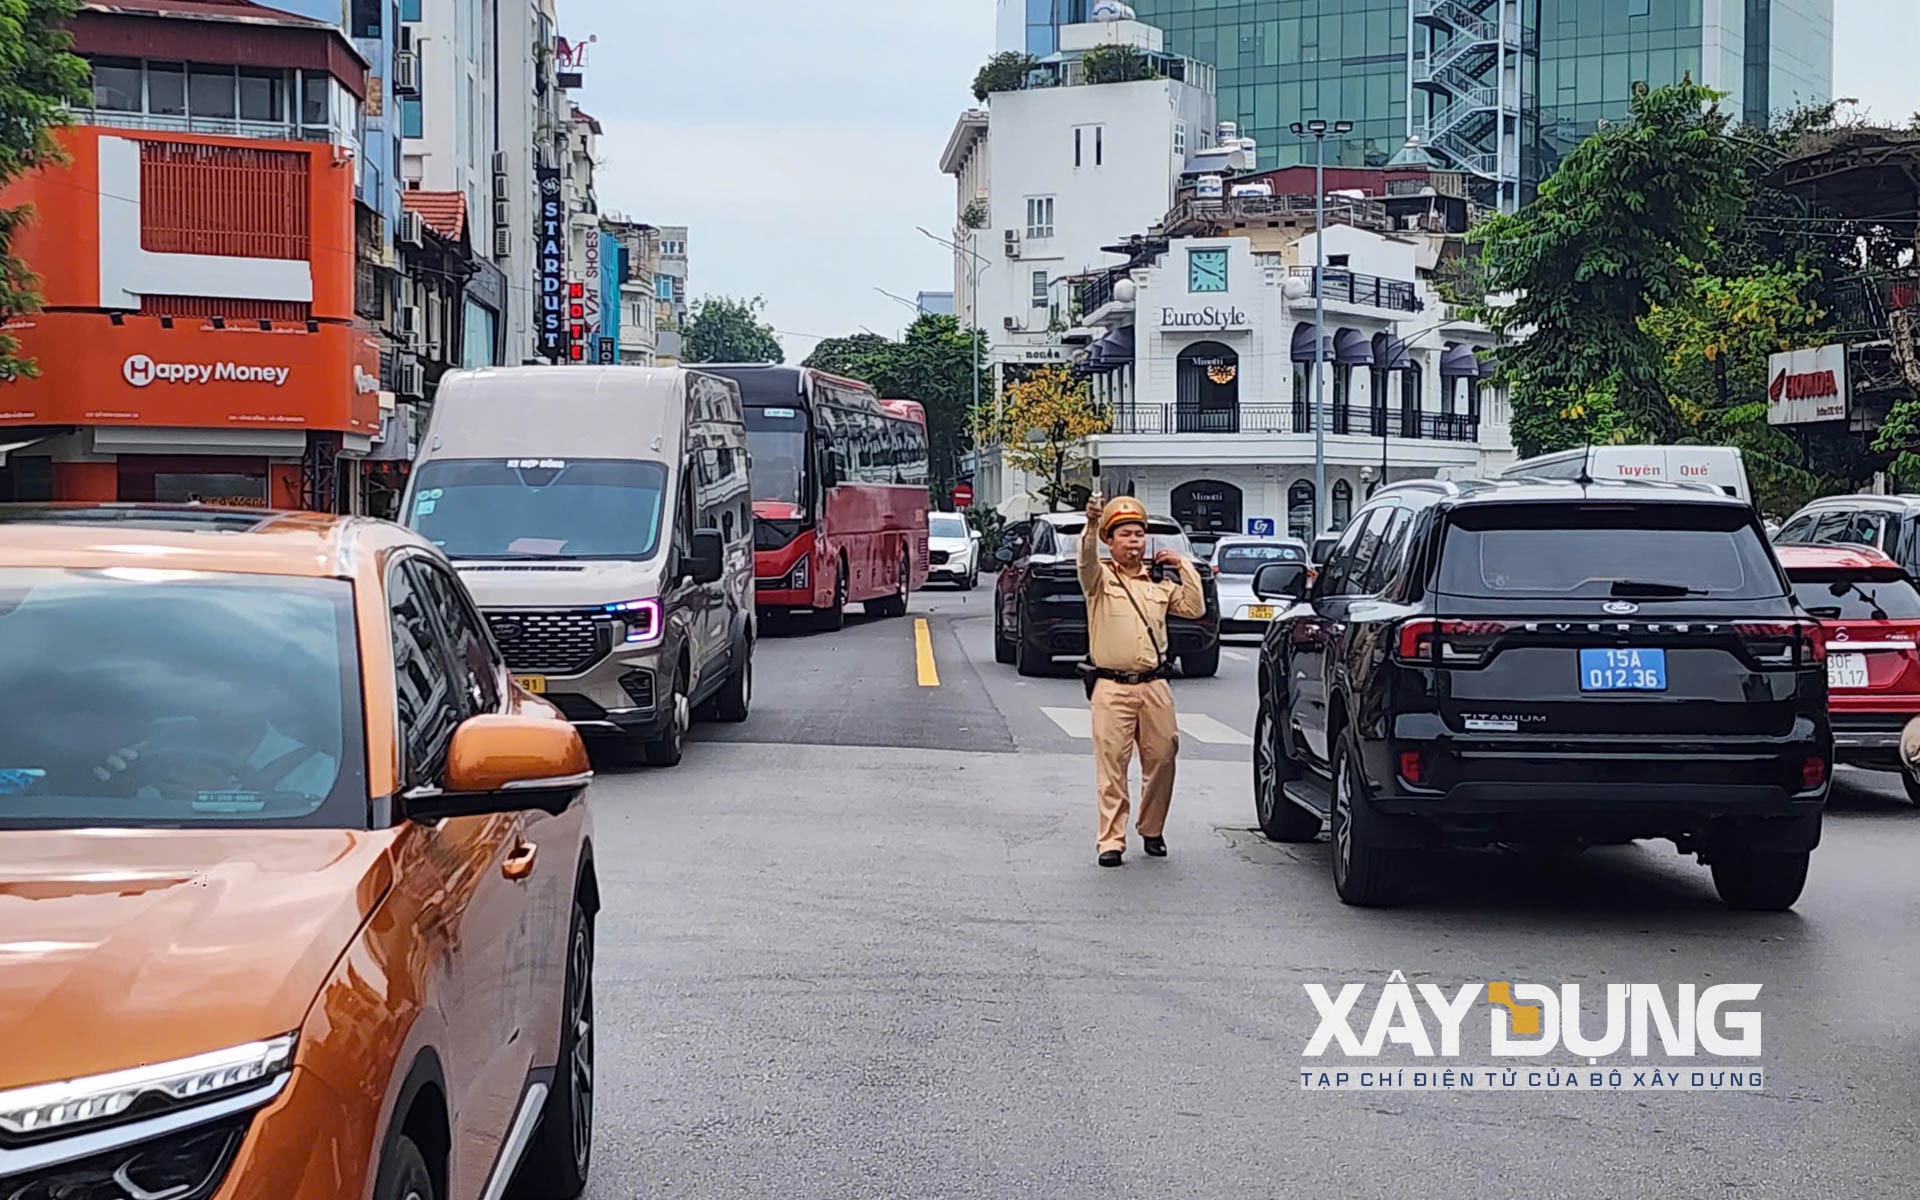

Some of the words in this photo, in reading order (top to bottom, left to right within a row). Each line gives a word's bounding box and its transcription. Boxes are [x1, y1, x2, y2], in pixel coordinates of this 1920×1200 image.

[585, 231, 599, 278] SHOES
[544, 202, 559, 348] STARDUST
[1161, 305, 1245, 331] EuroStyle
[123, 354, 213, 386] Happy
[214, 362, 290, 386] Money
[1785, 370, 1838, 400] HONDA
[1524, 623, 1719, 632] EVEREST
[1606, 651, 1642, 667] 15A
[1590, 669, 1658, 687] 012.36
[1460, 713, 1547, 722] TITANIUM
